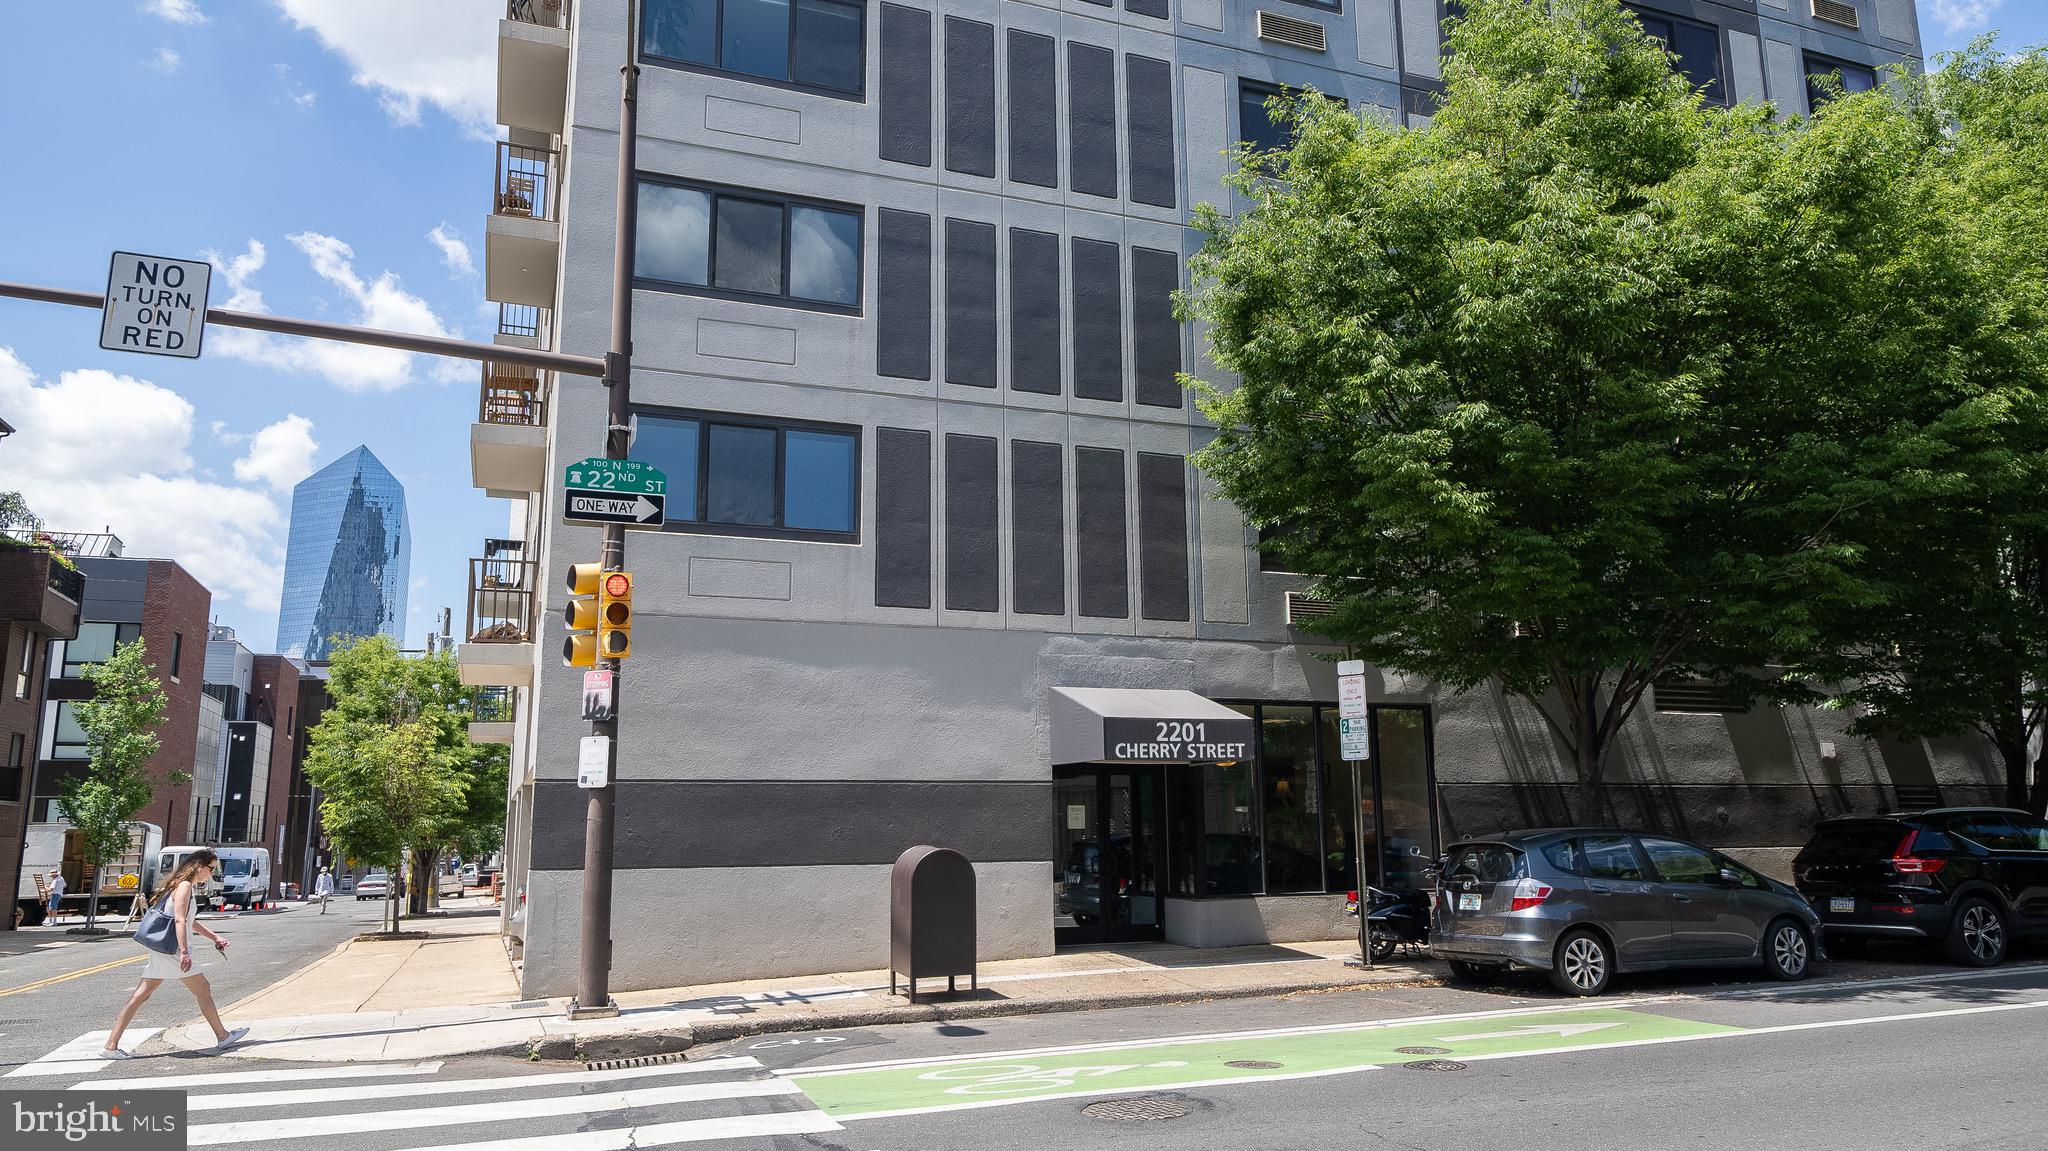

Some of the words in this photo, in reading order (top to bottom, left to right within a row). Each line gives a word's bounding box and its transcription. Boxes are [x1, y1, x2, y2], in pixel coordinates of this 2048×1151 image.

[135, 260, 185, 288] NO
[122, 285, 191, 310] TURN
[137, 307, 172, 327] ON
[122, 325, 184, 350] RED
[593, 460, 608, 468] 100
[612, 461, 621, 470] N
[587, 470, 636, 489] 22ND
[645, 480, 664, 492] ST
[576, 498, 603, 512] ONE
[608, 501, 636, 514] WAY
[1156, 721, 1205, 742] 2201
[1342, 721, 1349, 732] 2
[1115, 742, 1181, 759] CHERRY
[1187, 743, 1246, 759] STREET
